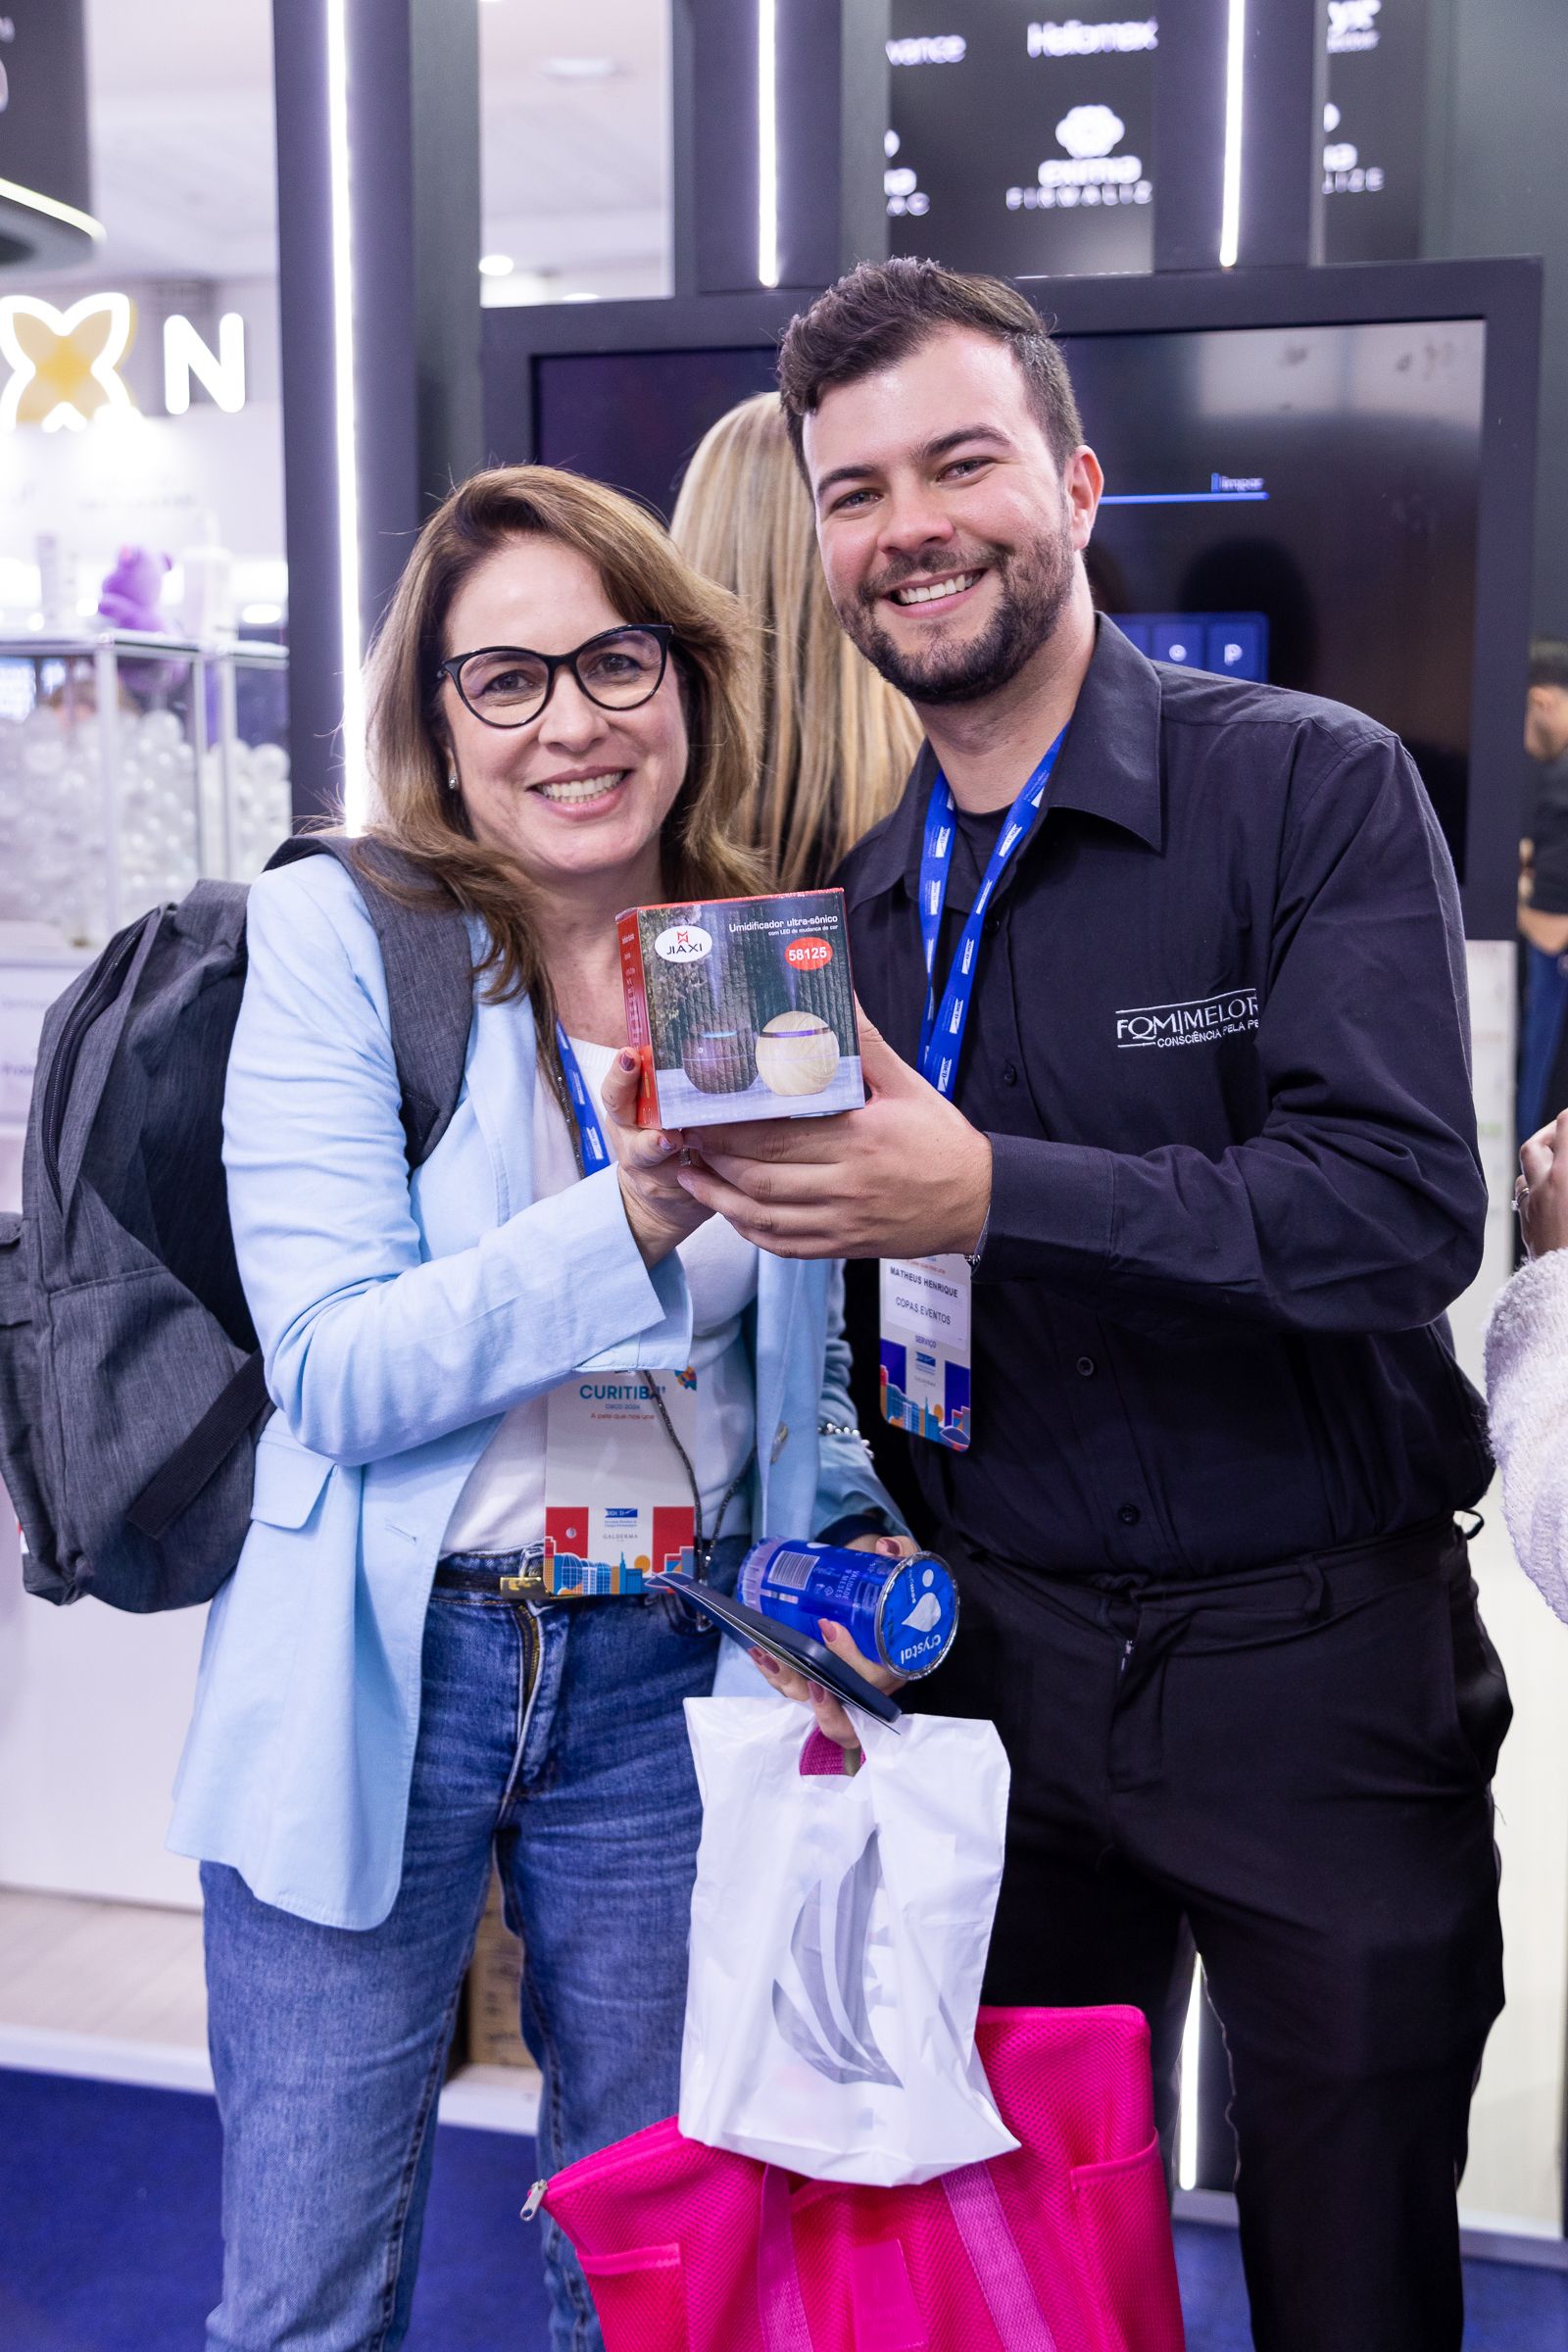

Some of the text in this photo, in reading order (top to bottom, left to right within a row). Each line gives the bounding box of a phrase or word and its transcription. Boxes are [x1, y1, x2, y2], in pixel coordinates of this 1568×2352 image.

[728, 914, 838, 932] Umidificador ultra-sônico
[666, 943, 703, 955] JIAXI
[788, 947, 828, 961] 58125
[1156, 1027, 1222, 1049] CONSCIÊNCIA
[1222, 1022, 1246, 1036] PELA
[890, 1266, 922, 1285] MATHEUS
[923, 1278, 958, 1298] HENRIQUE
[896, 1297, 951, 1325] COPAS EVENTOS
[579, 1384, 658, 1399] CURITIB
[835, 1575, 850, 1598] MESES
[842, 1570, 860, 1599] VALIDADE
[901, 1634, 942, 1664] crystal
